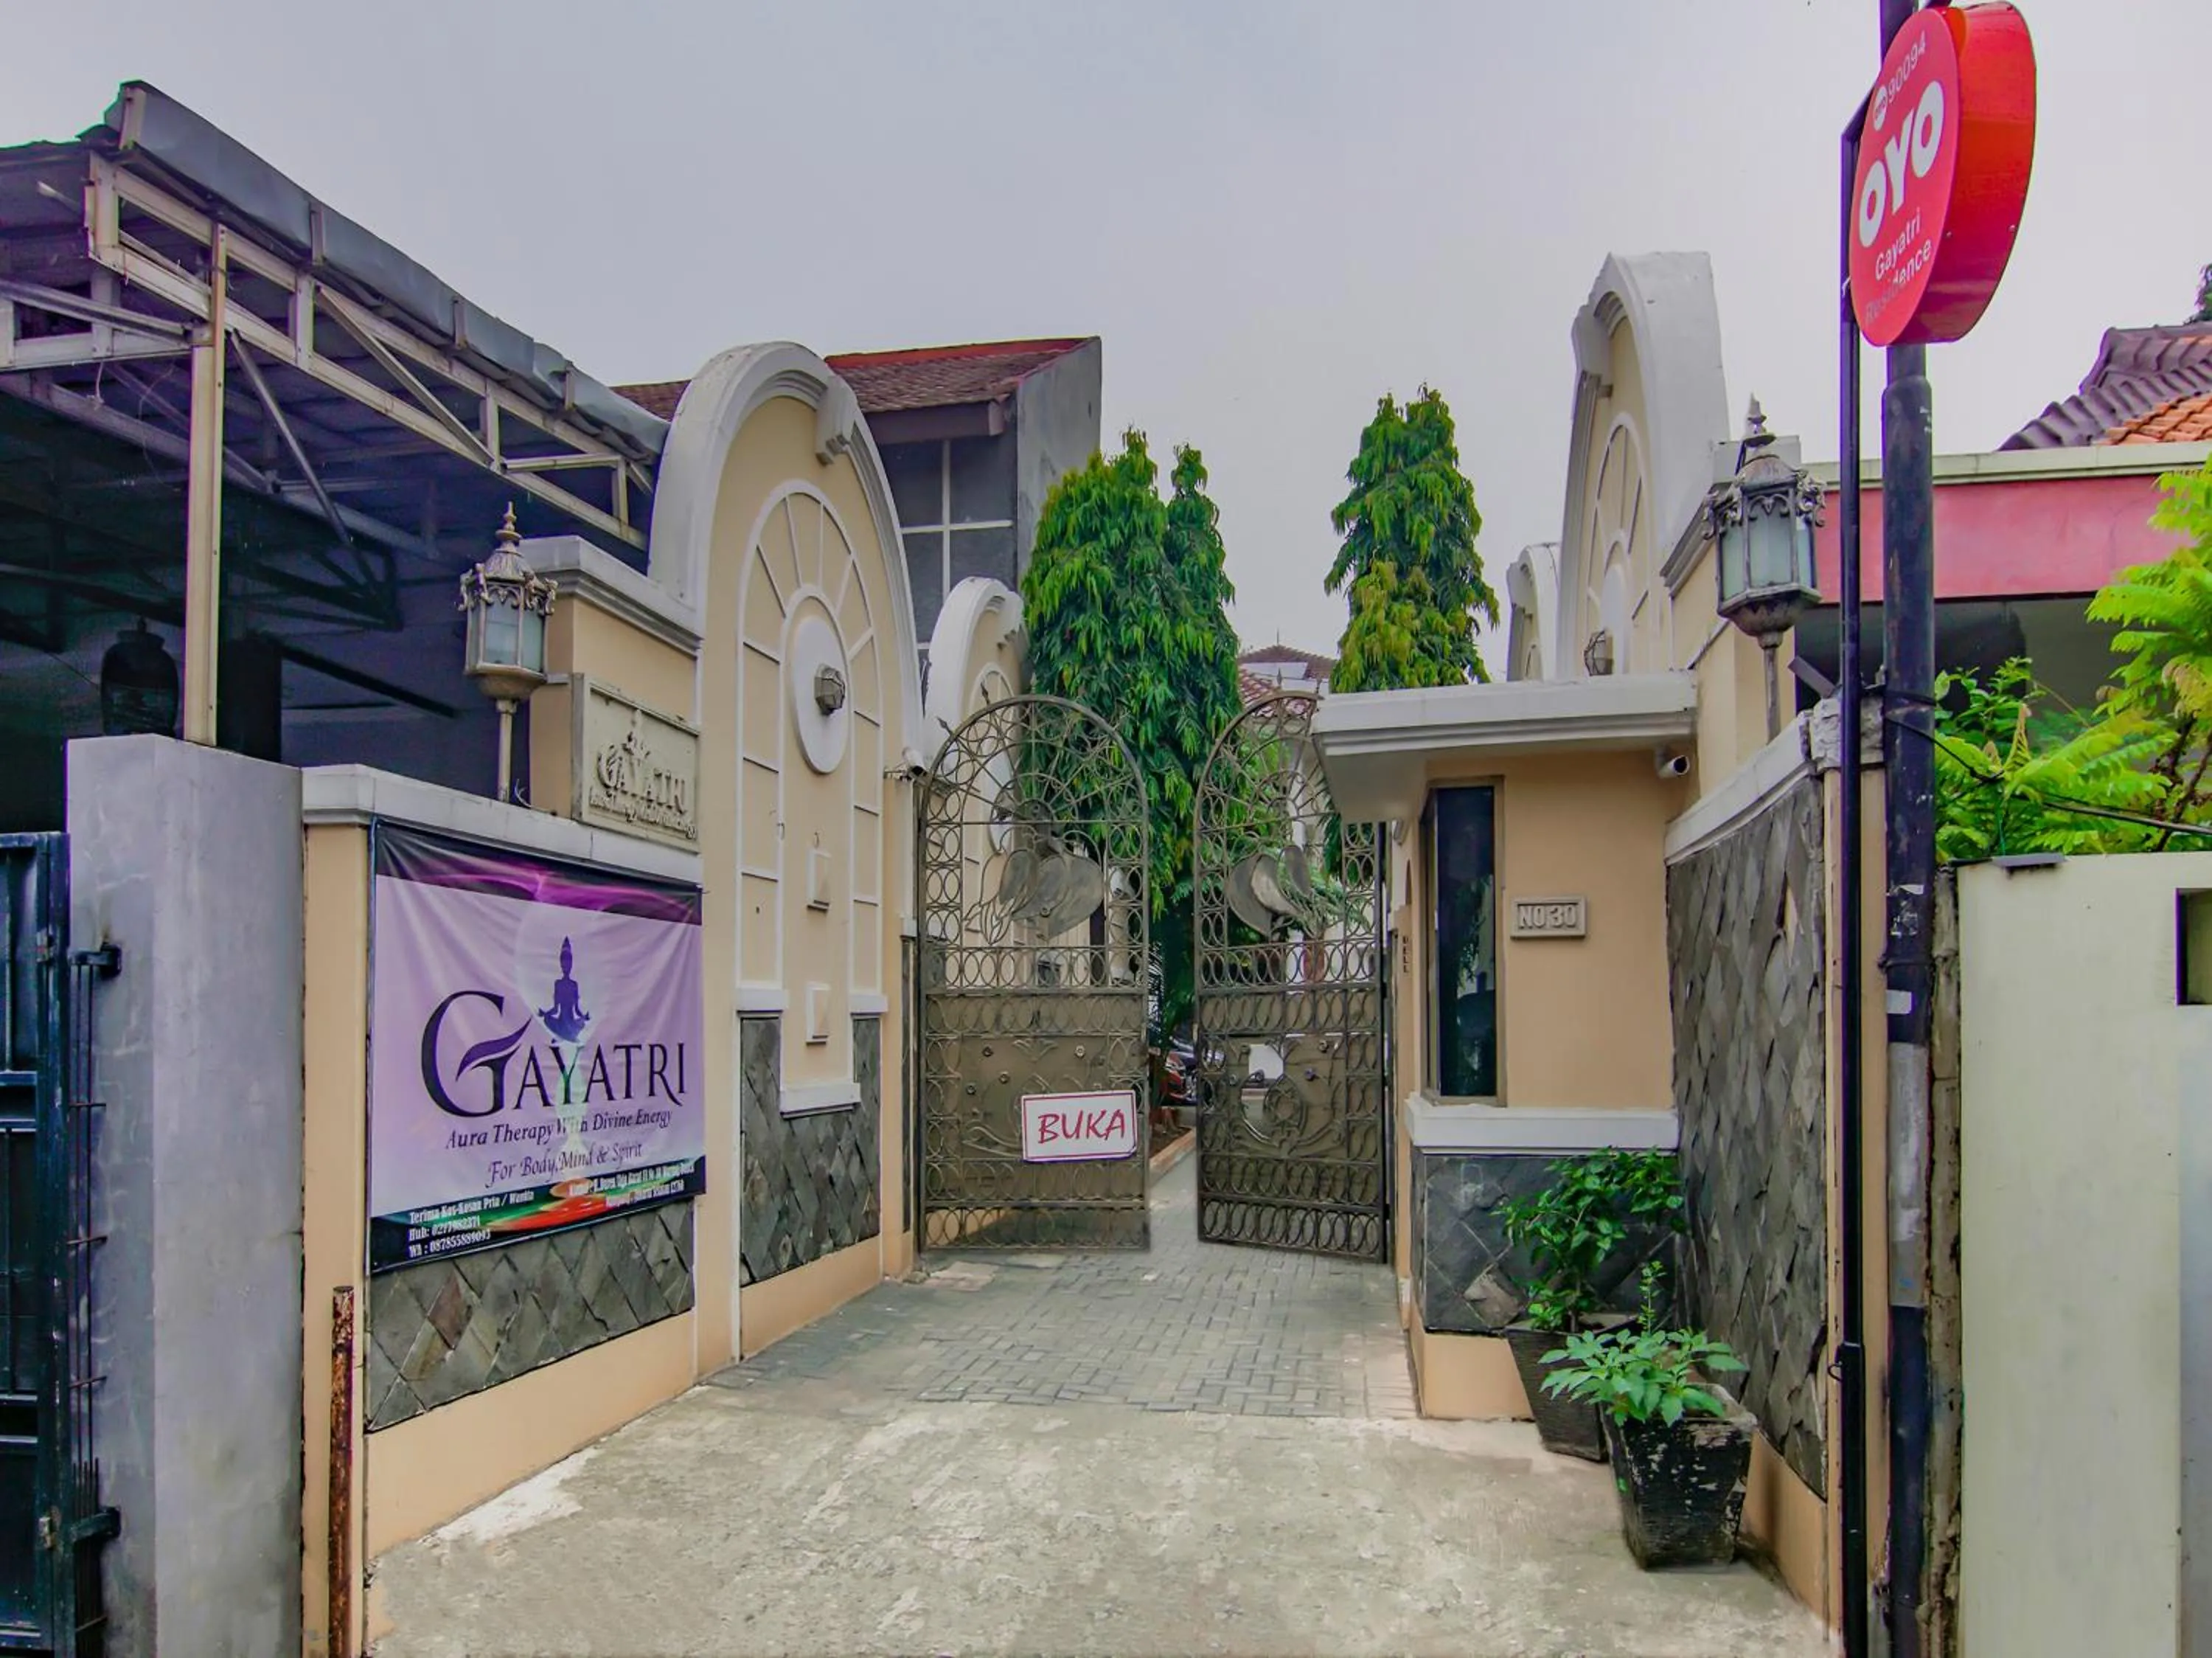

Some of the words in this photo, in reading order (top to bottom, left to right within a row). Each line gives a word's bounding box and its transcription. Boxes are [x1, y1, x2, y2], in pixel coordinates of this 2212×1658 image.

[1888, 30, 1927, 103] 90094
[1859, 80, 1944, 248] OYO
[1875, 206, 1921, 281] Gayatri
[421, 990, 686, 1118] GAYATRI
[446, 1130, 488, 1149] Aura
[493, 1123, 554, 1145] Therapy
[557, 1115, 588, 1134] Wh
[593, 1111, 633, 1131] Divine
[636, 1109, 672, 1129] Energy
[1037, 1109, 1125, 1144] BUKA
[485, 1160, 515, 1188] For
